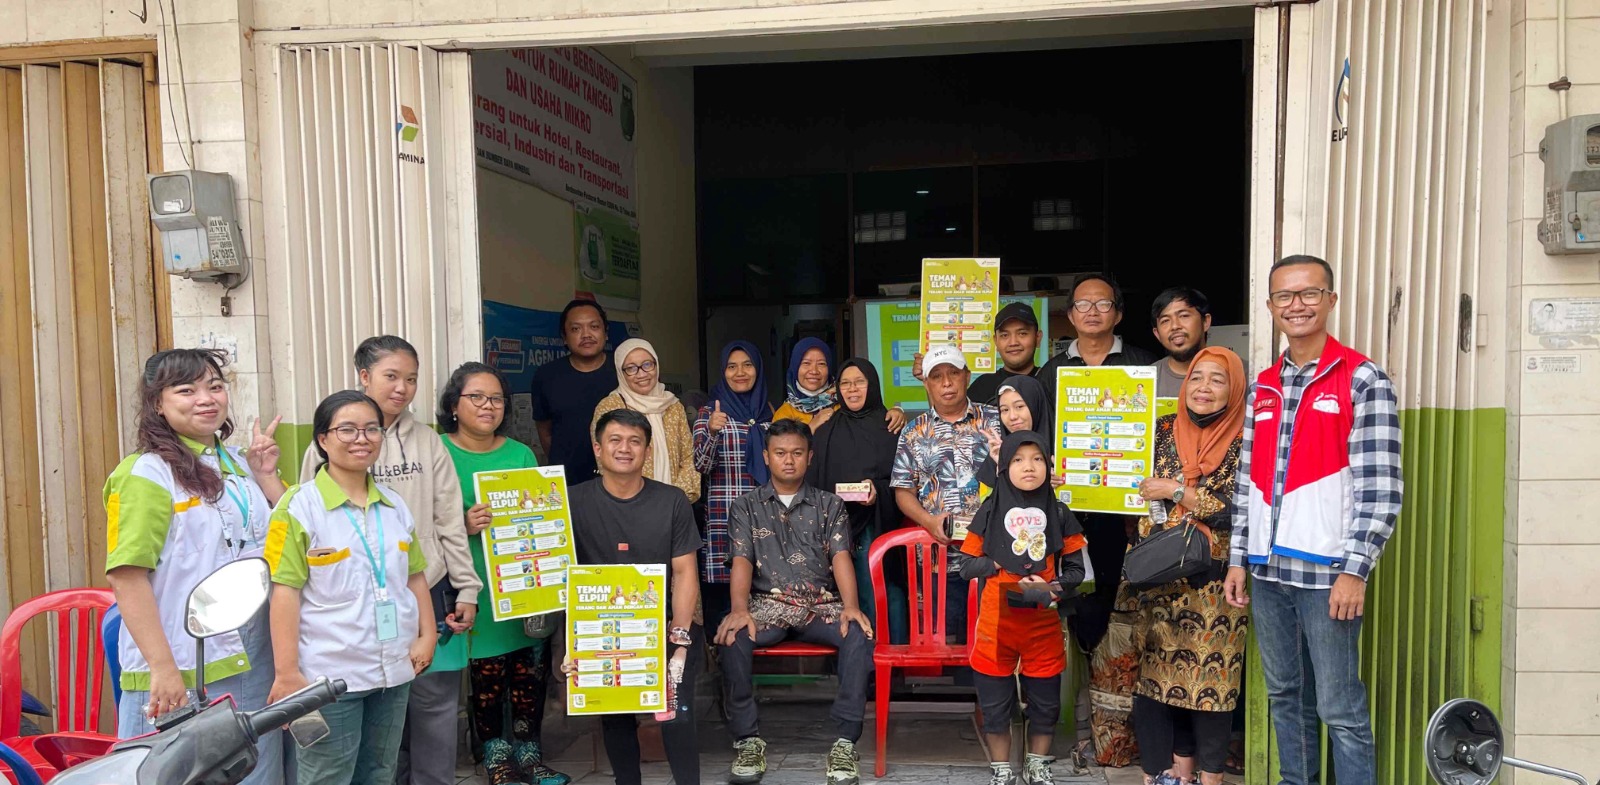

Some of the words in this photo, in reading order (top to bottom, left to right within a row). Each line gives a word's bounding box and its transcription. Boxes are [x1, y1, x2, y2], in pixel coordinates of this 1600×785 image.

[573, 48, 619, 94] BERSUBSIDI
[549, 58, 580, 96] RUMAH
[582, 78, 614, 117] TANGGA
[506, 67, 528, 100] DAN
[530, 82, 562, 119] USAHA
[564, 101, 592, 134] MIKRO
[509, 110, 540, 136] untuk
[544, 125, 573, 156] Hotel,
[576, 140, 622, 178] Restaurant,
[514, 132, 556, 166] Industri
[558, 156, 576, 175] dan
[578, 162, 629, 200] Transportasi
[528, 348, 554, 366] AGEN
[1066, 387, 1099, 395] TEMAN
[1068, 395, 1096, 404] ELPIJI
[487, 490, 519, 500] TEMAN
[491, 498, 518, 509] ELPIJI
[1009, 516, 1042, 528] LOVE
[576, 585, 611, 594] TEMAN
[579, 594, 608, 602] ELPIJI
